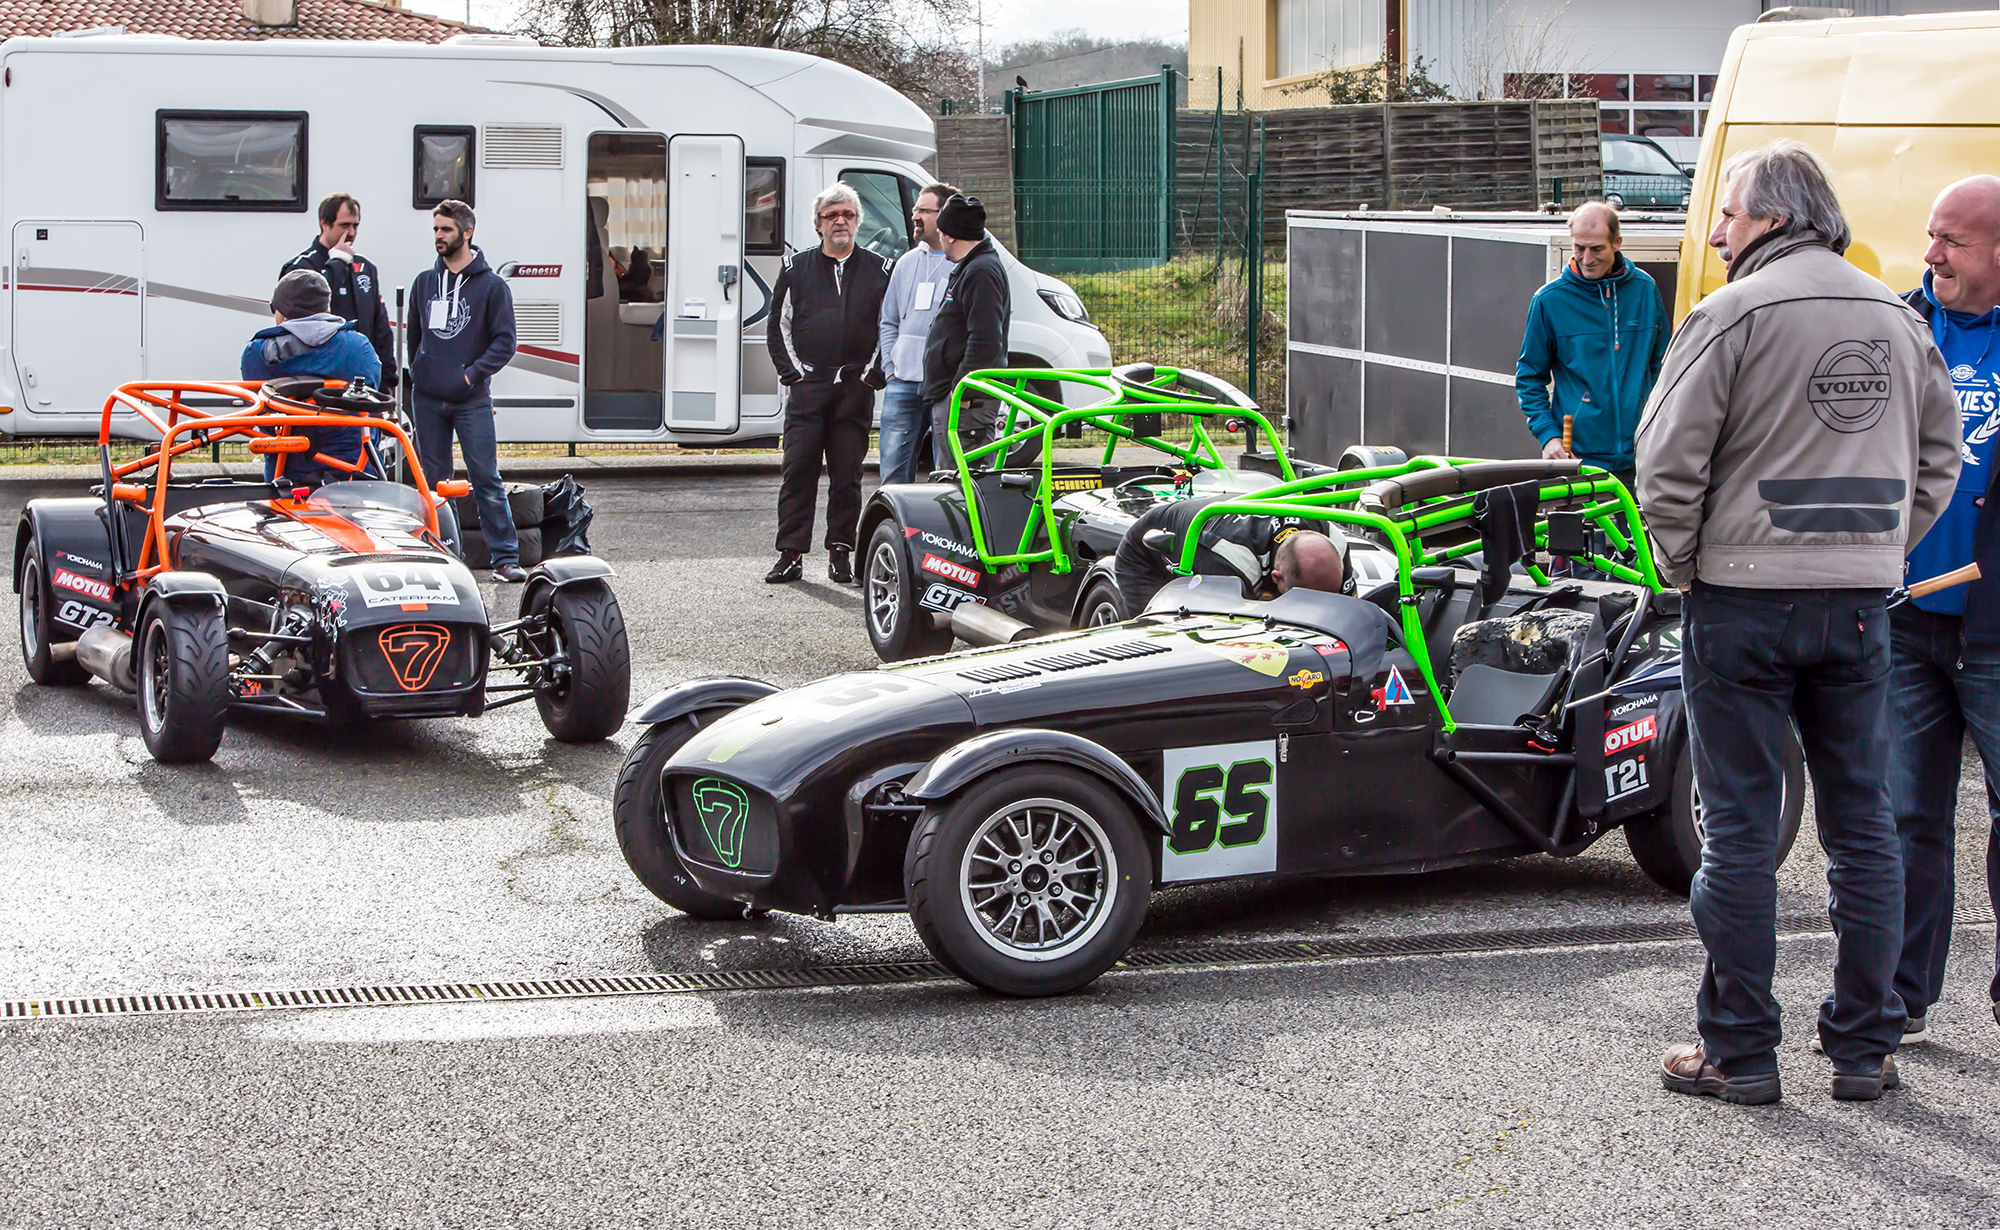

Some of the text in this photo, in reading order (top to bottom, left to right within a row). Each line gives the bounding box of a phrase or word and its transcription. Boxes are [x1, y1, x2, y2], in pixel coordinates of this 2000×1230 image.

[518, 266, 559, 276] Genesis
[1814, 380, 1888, 395] VOLVO
[921, 530, 979, 560] YOKOHAMA
[66, 553, 103, 571] YOKOHAMA
[925, 556, 976, 585] MOTUL
[56, 571, 111, 600] MOTUL
[360, 567, 443, 593] 64
[368, 595, 456, 604] CATERHAM
[925, 583, 986, 609] GT
[388, 630, 442, 682] 7
[1290, 671, 1322, 690] NOGARO
[1612, 693, 1659, 717] YOKOHAMA
[1605, 719, 1653, 753] OTUL
[1166, 757, 1275, 856] 65
[699, 786, 743, 857] 7
